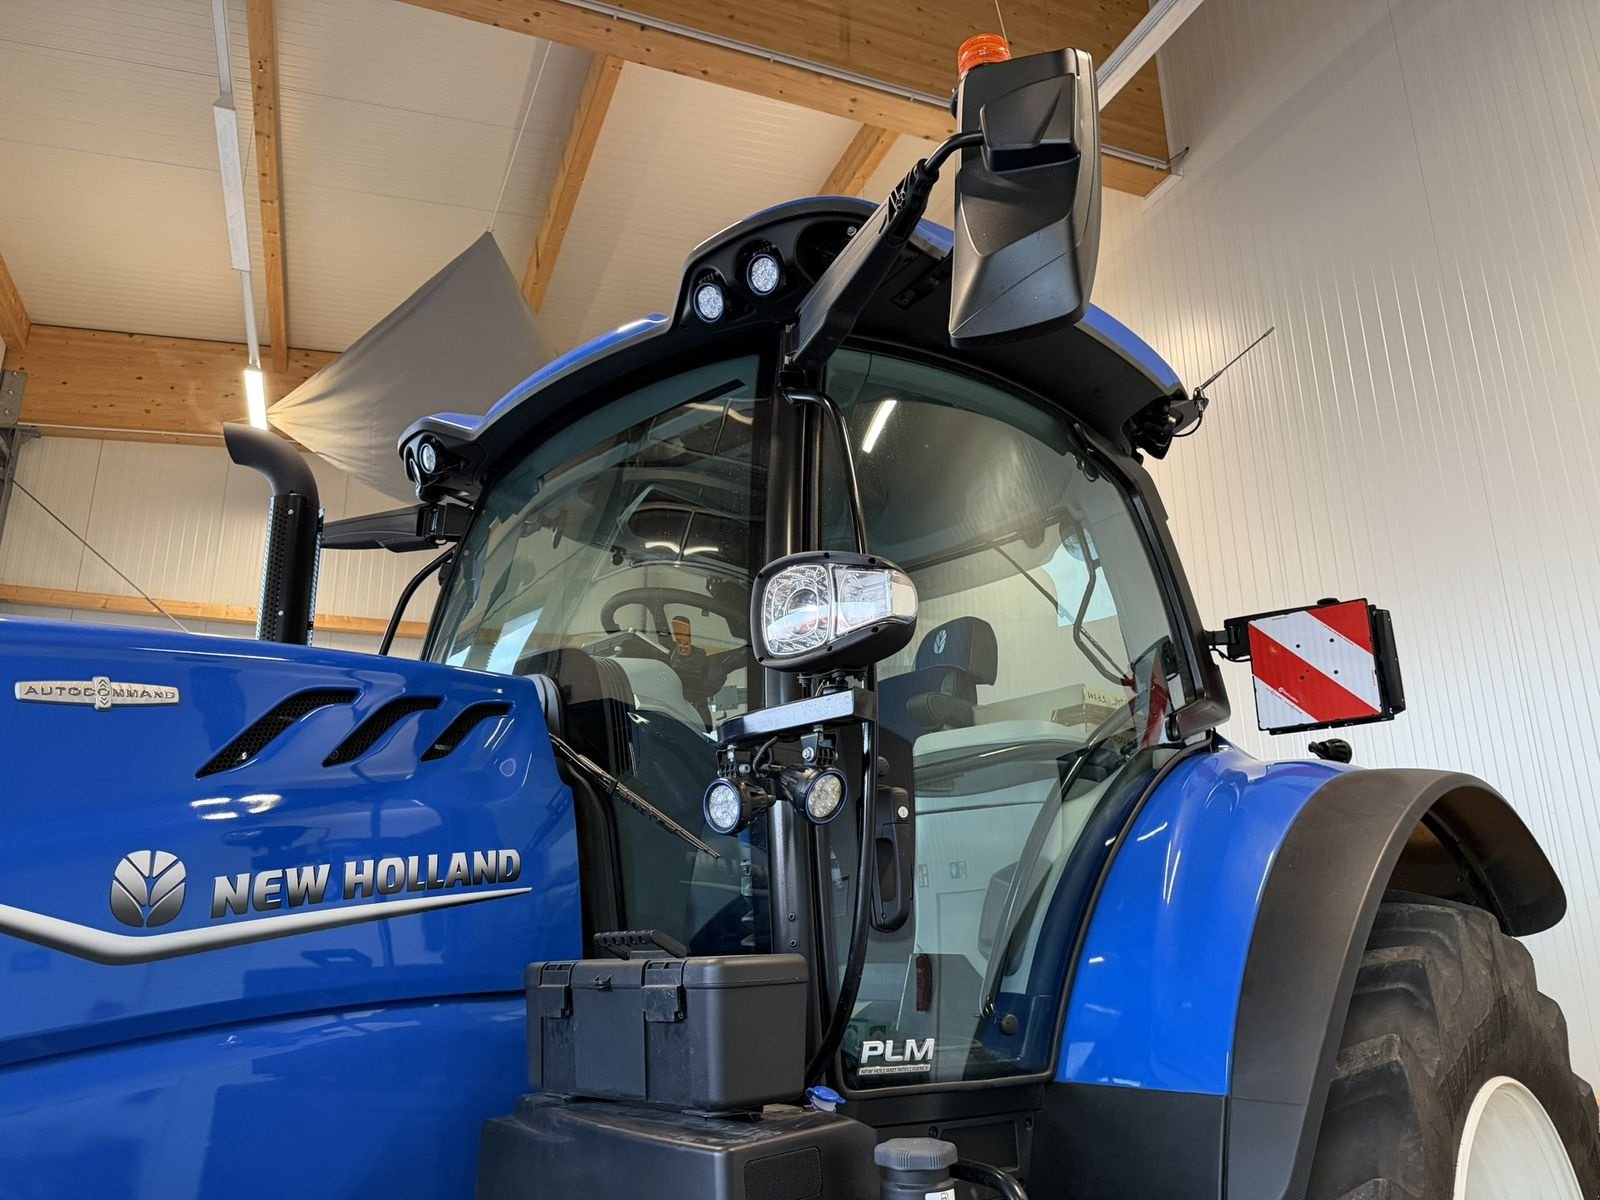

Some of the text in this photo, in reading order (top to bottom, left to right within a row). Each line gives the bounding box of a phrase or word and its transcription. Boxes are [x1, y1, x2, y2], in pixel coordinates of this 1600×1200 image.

[24, 685, 176, 700] AUTOCOMMAND
[210, 849, 521, 919] NEW HOLLAND
[860, 1038, 935, 1064] PLM
